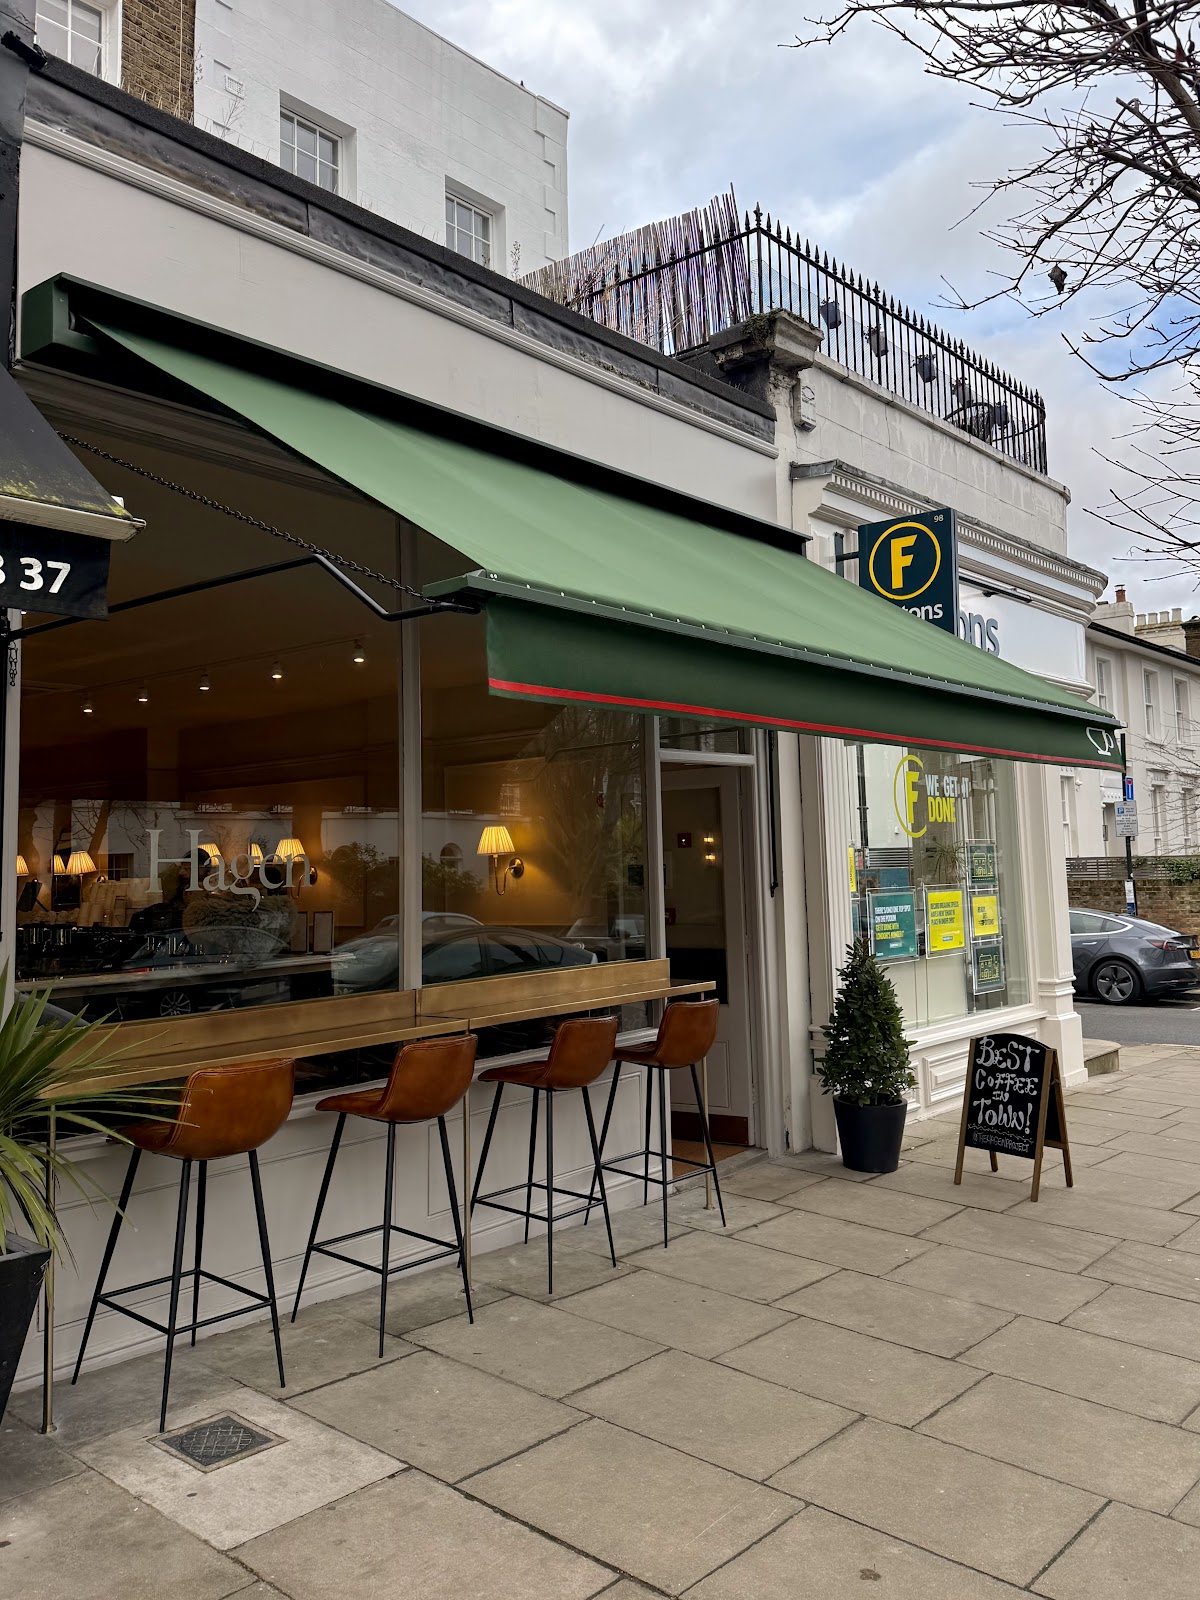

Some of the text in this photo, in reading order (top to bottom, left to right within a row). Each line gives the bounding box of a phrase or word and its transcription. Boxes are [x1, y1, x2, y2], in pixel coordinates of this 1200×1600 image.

[934, 514, 944, 523] 98
[20, 556, 71, 594] 37
[890, 534, 918, 590] F
[925, 774, 969, 798] WE GET IT
[928, 797, 956, 823] DONE
[145, 829, 312, 912] Hagen
[976, 1036, 1040, 1072] BEST
[992, 1091, 1009, 1102] IN
[973, 1098, 1033, 1134] TOWN!
